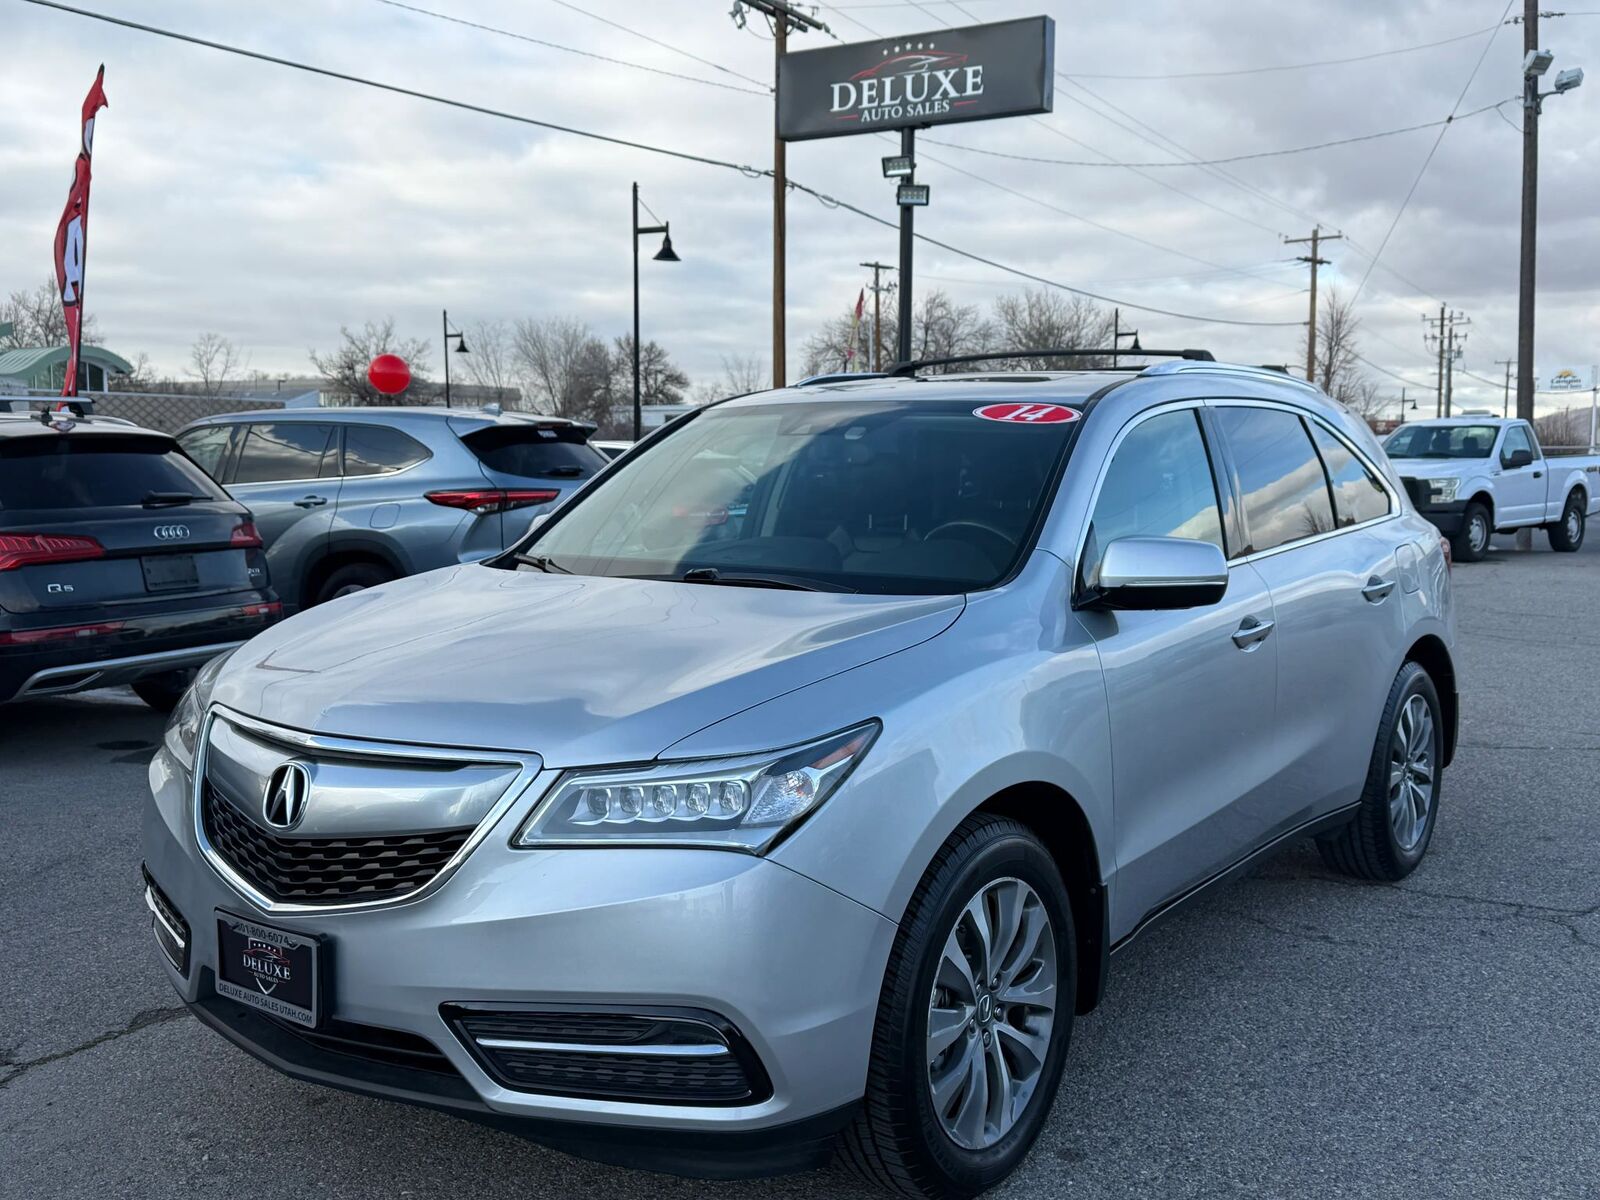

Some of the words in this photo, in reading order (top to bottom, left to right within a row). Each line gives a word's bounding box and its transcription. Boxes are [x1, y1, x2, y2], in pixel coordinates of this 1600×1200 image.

[829, 65, 984, 112] DELUXE
[861, 105, 902, 123] AUTO
[907, 100, 951, 117] SALES
[998, 405, 1057, 421] 14
[243, 953, 291, 980] DELUXE
[219, 983, 242, 999] DELUXE
[243, 992, 260, 1005] AUTO
[260, 998, 279, 1012] SALES
[279, 1005, 313, 1024] UTAH.COM
